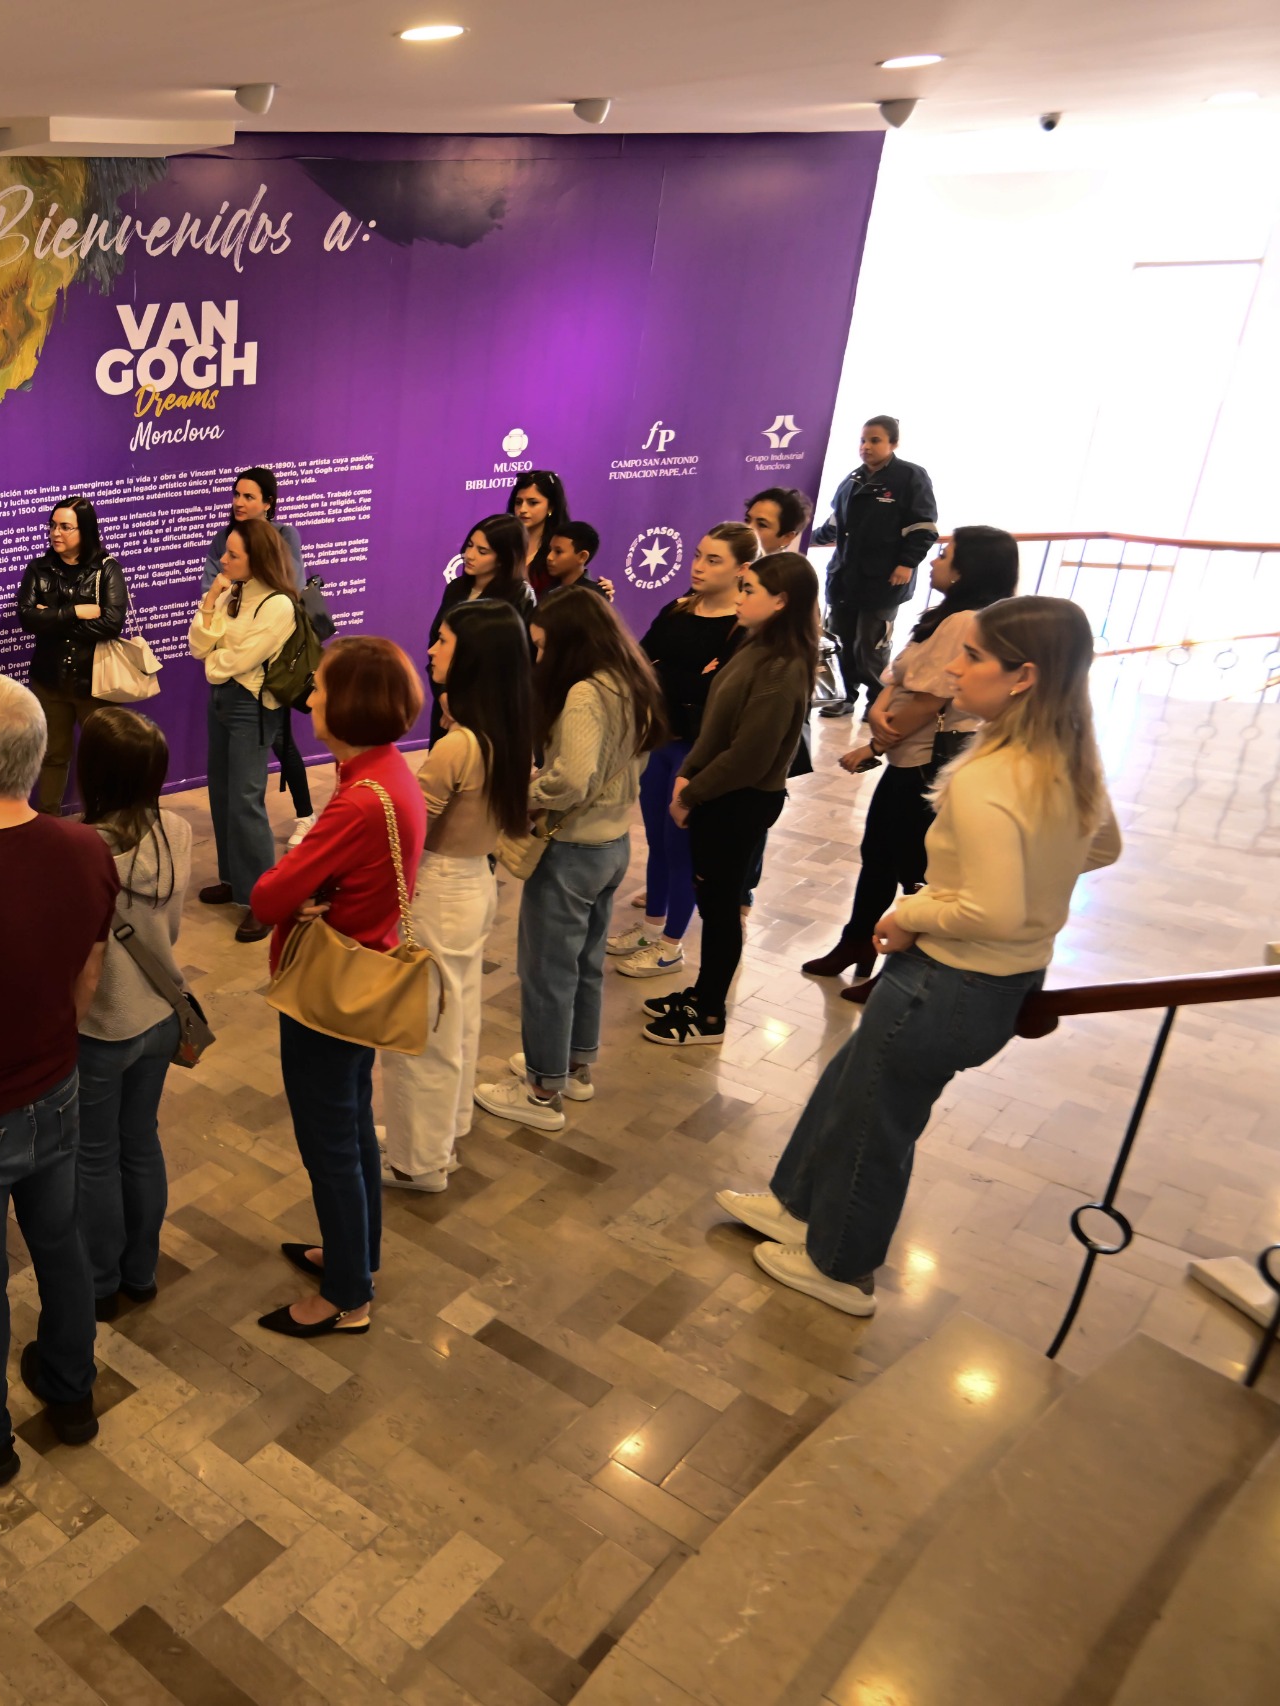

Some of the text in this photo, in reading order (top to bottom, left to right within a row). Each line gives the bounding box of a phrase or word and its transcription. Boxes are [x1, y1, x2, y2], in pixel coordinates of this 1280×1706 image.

[324, 211, 376, 251] a:
[116, 299, 239, 351] VAN
[95, 341, 258, 396] GOGH
[134, 383, 217, 418] Dreams
[130, 419, 224, 451] Monclova
[611, 456, 698, 468] CAMPO SAN ANTONIO
[745, 452, 804, 463] Grupo Industrial
[70, 481, 113, 490] sumergirnos
[160, 472, 176, 481] obra
[190, 469, 216, 477] Vincent
[350, 455, 374, 463] pasión,
[494, 461, 532, 472] MUSEO
[659, 468, 680, 477] PAPE,
[682, 467, 697, 475] A.C.
[755, 462, 791, 470] Monclova
[466, 477, 517, 490] BIBLIOTE
[18, 506, 36, 514] 1500
